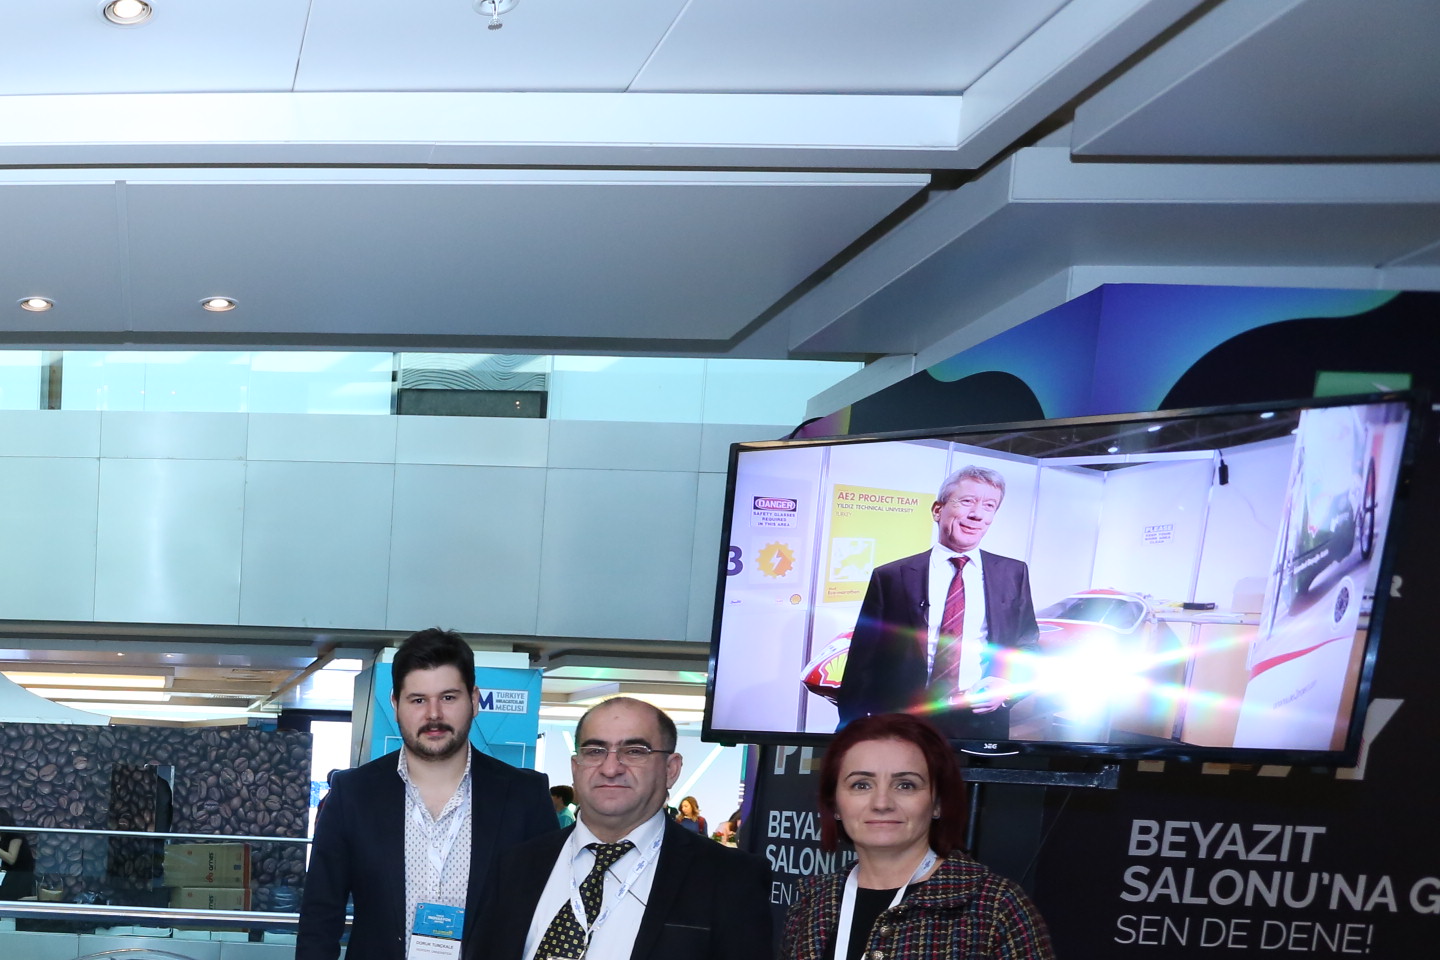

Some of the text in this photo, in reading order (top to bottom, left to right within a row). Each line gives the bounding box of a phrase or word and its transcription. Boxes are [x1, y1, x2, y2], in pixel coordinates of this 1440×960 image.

[758, 500, 793, 509] DANGER
[838, 492, 918, 506] AE2 PROJECT TEAM
[1127, 819, 1326, 863] BEYAZIT
[1120, 865, 1398, 912] SALONU'NA
[1114, 914, 1374, 954] SEN DE DENE!
